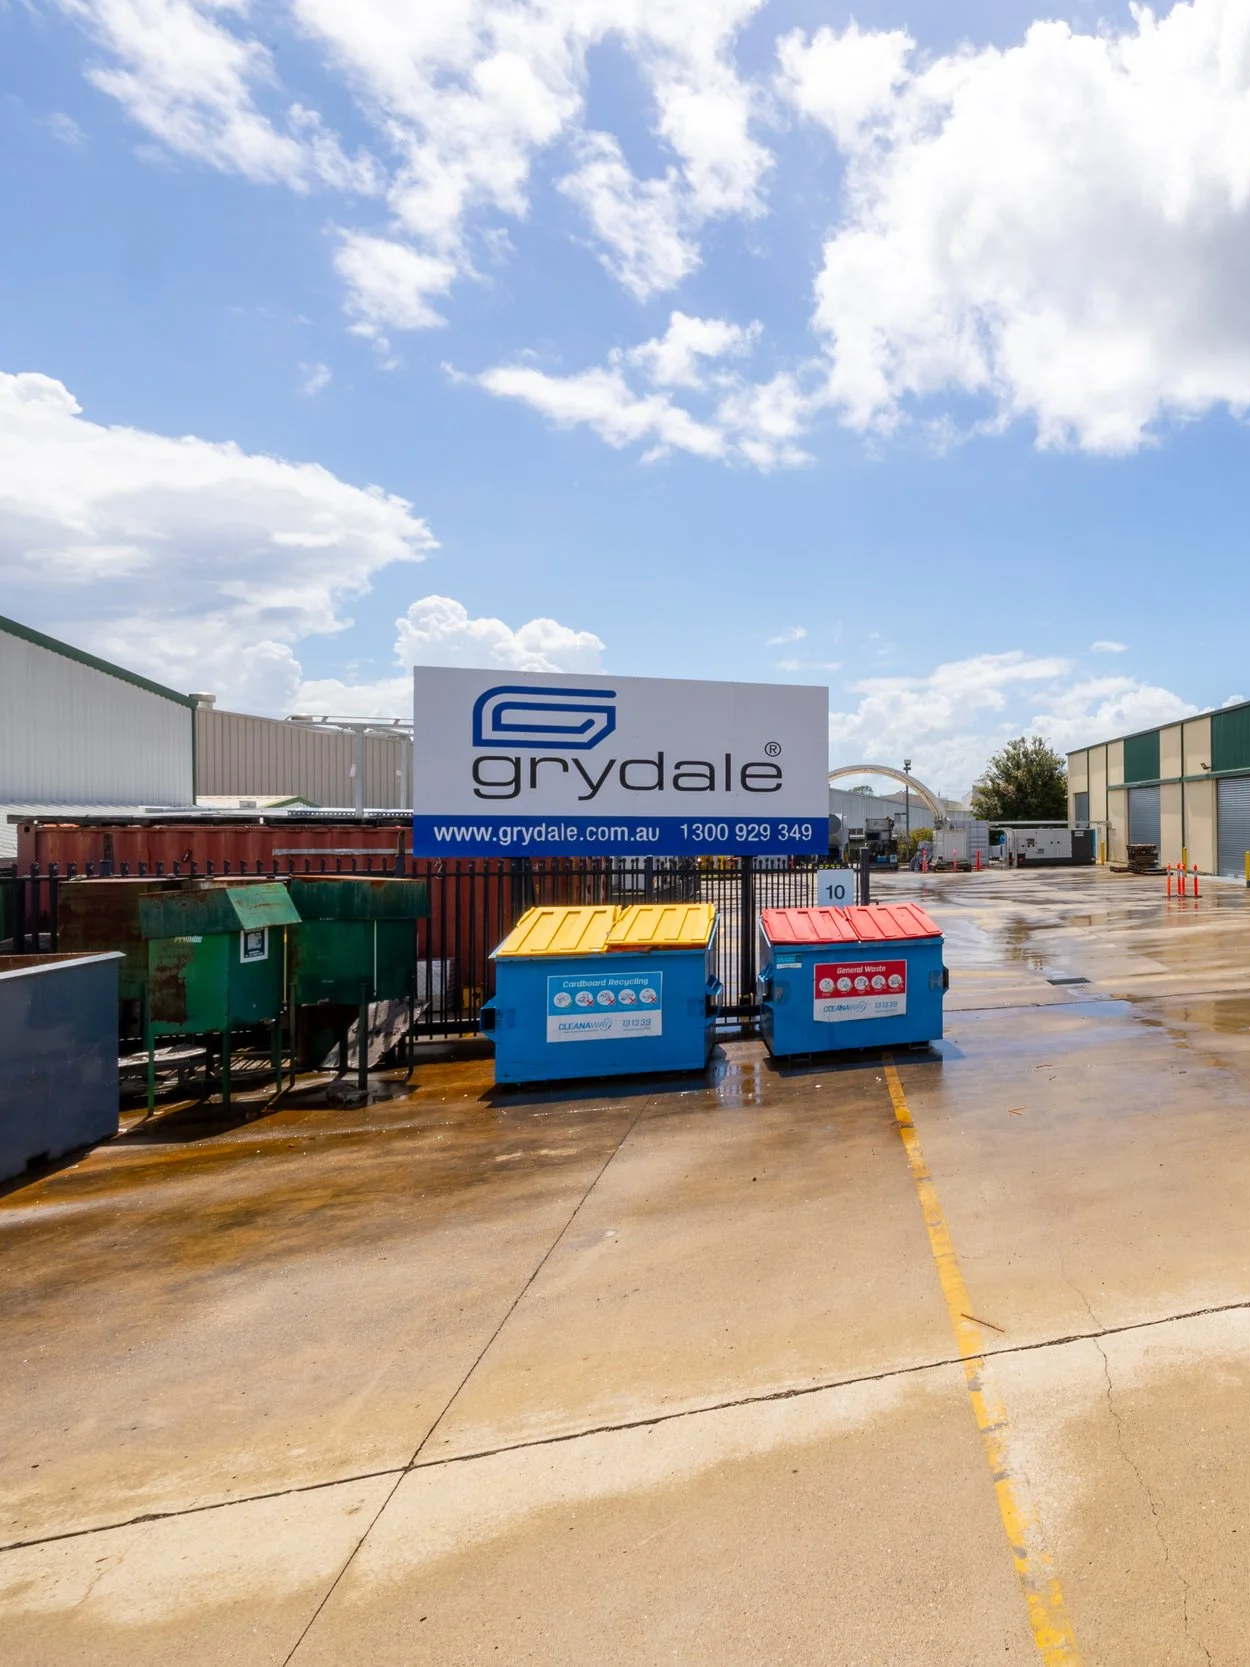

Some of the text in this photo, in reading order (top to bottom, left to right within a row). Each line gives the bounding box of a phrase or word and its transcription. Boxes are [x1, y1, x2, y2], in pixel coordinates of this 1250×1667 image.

[472, 751, 783, 801] grydale
[434, 823, 813, 846] www.grydale.com.au 1300 929 349
[825, 884, 845, 900] 10
[836, 965, 887, 975] General Waste
[562, 977, 649, 988] Cardboard Recycling
[823, 1003, 865, 1013] CLEANAWAY
[558, 1020, 610, 1031] CLEANAWAY
